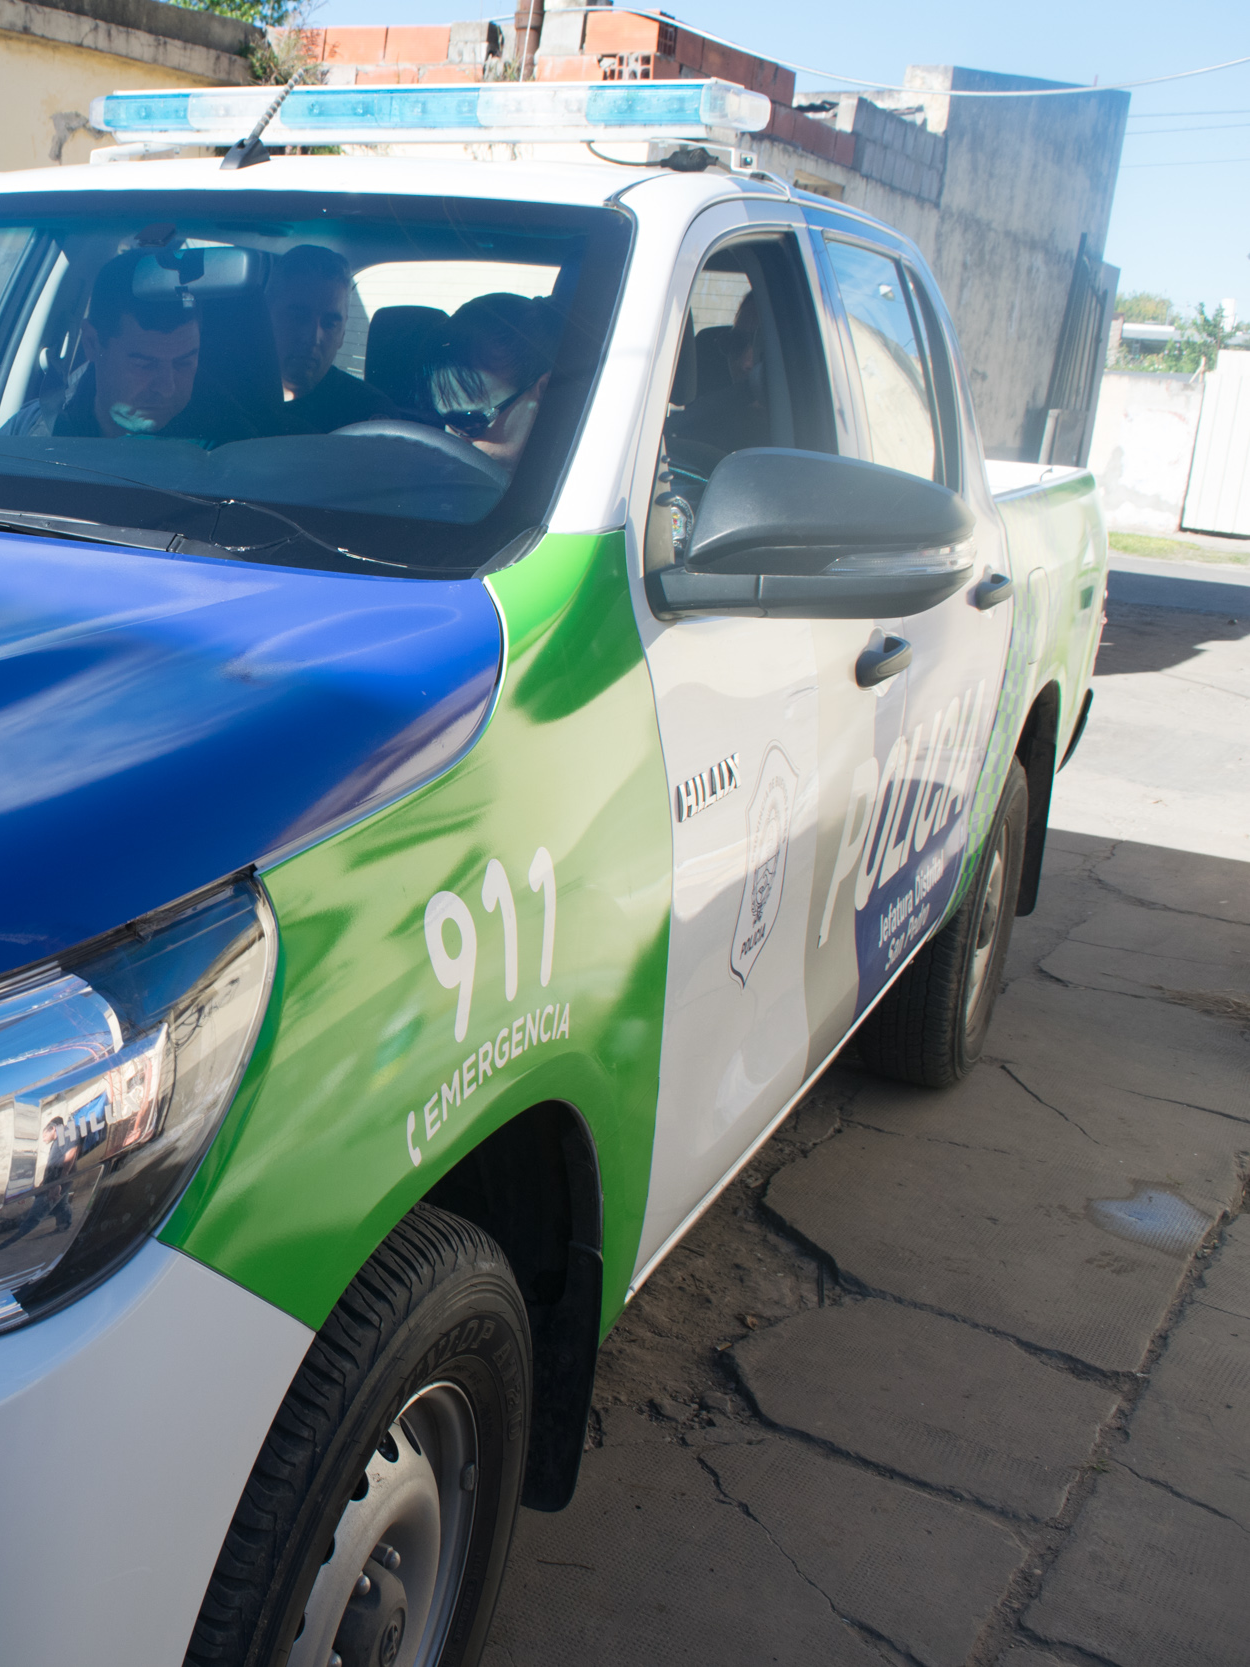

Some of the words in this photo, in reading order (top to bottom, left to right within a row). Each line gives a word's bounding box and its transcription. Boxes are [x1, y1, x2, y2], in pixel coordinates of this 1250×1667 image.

[673, 752, 742, 823] HILUX
[817, 678, 986, 949] POLICIA
[423, 846, 557, 1043] 911
[739, 922, 766, 960] POLICIA
[878, 889, 914, 948] Jefatura
[914, 848, 944, 906] Distrital
[55, 1085, 143, 1147] HILUX
[423, 1002, 570, 1141] EMERGENCIA
